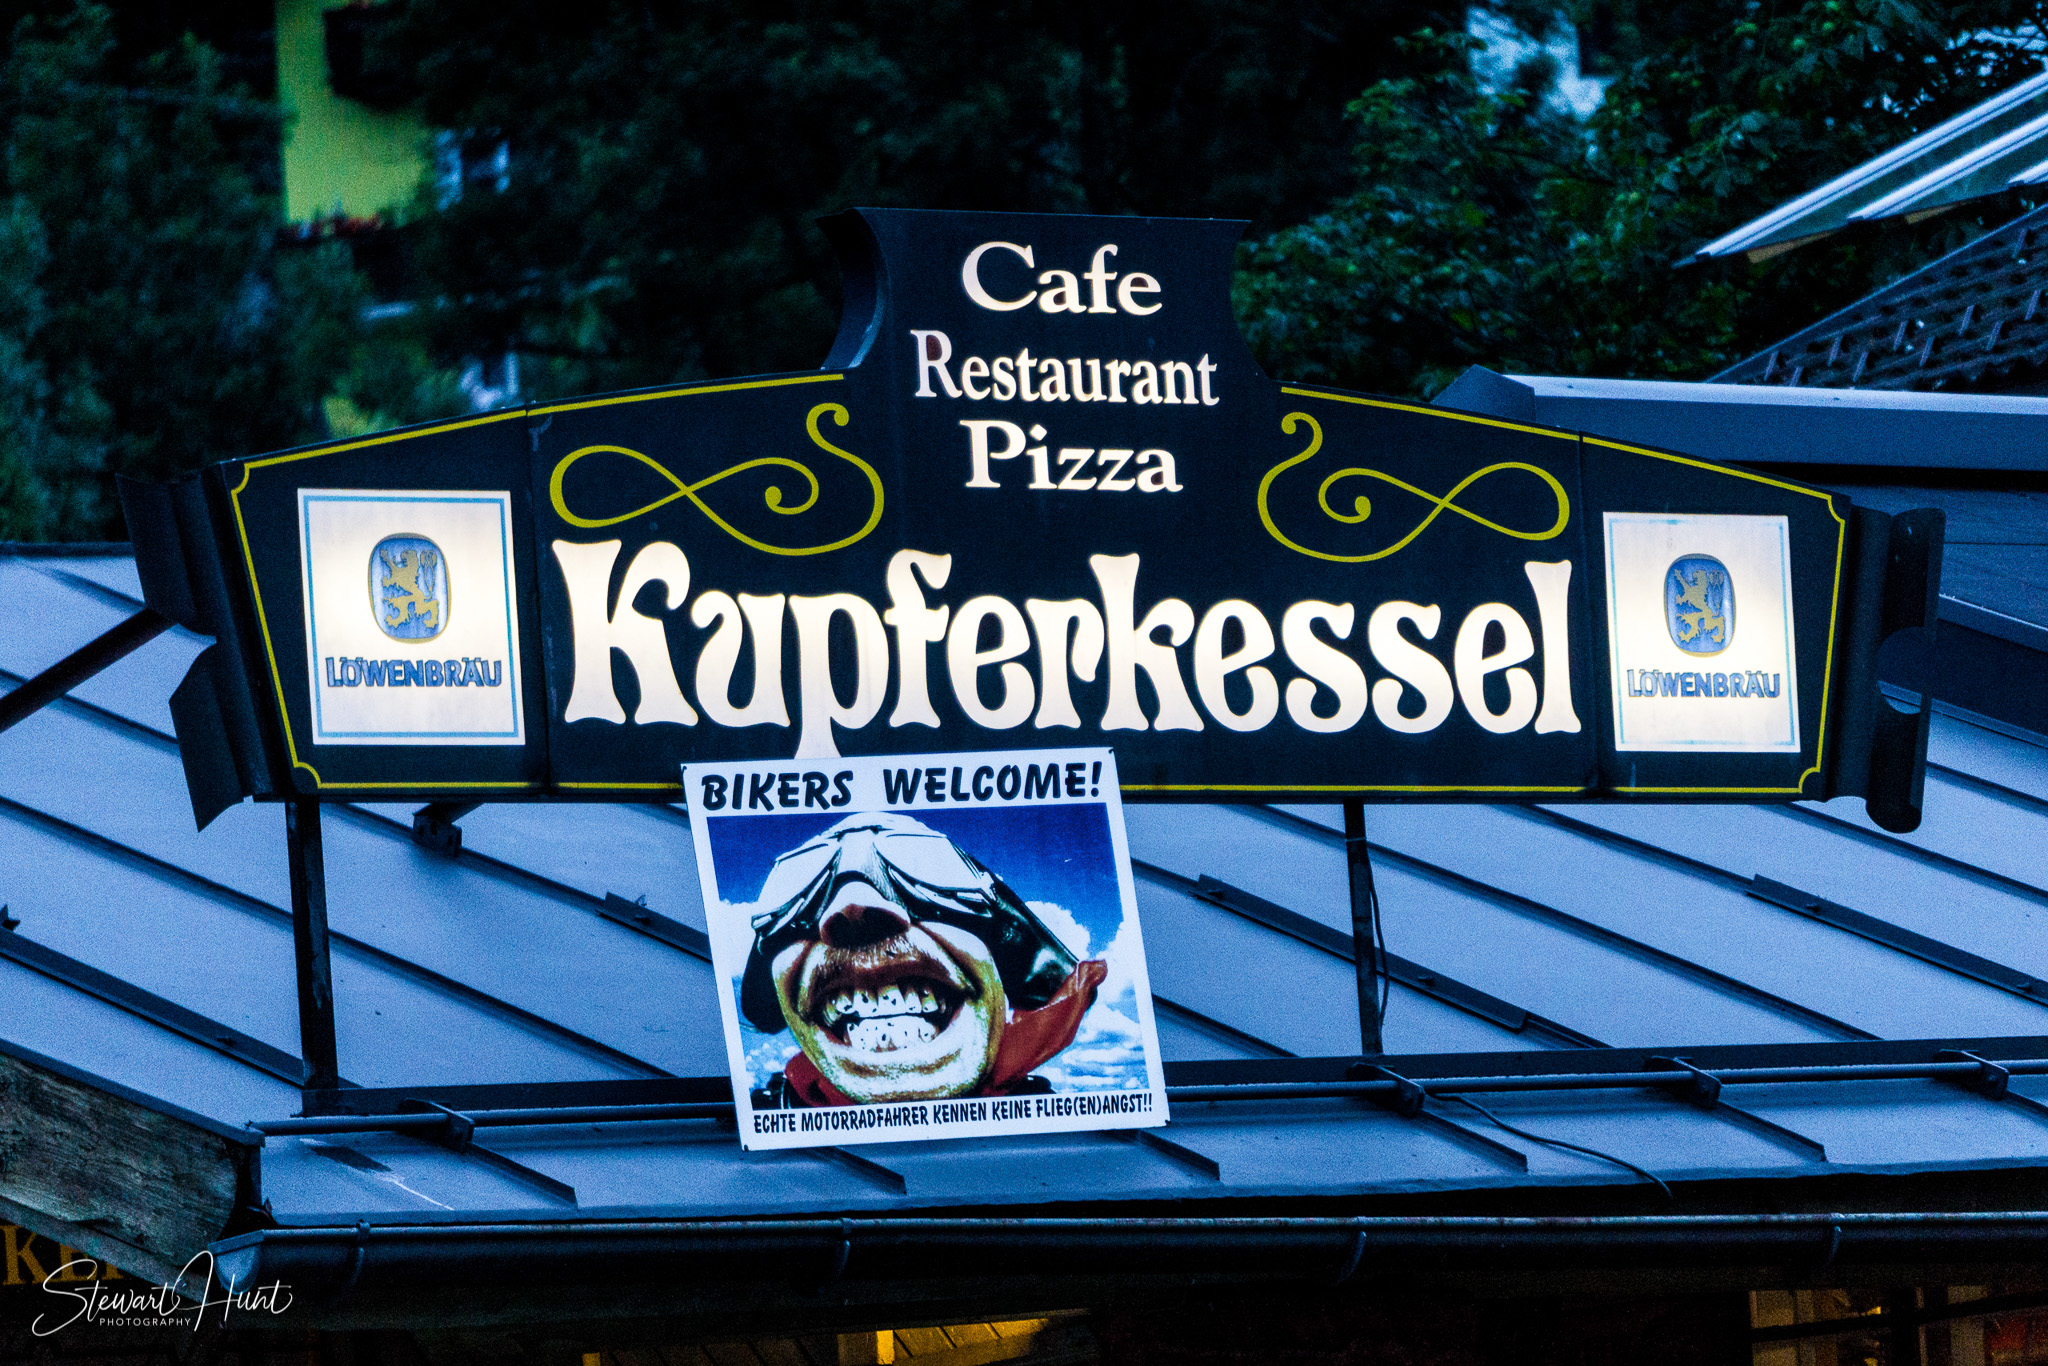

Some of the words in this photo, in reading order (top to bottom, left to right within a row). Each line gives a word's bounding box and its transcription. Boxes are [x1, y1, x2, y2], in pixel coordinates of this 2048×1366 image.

[962, 241, 1162, 316] Cafe
[910, 329, 1219, 406] Restaurant
[960, 420, 1183, 492] Pizza
[325, 656, 502, 687] LÖWENBRÄU
[552, 539, 1582, 758] Kupferkessel
[1626, 668, 1781, 698] LÖWENBRÄU
[701, 771, 854, 812] BIKERS
[884, 761, 1104, 805] WELCOME!
[753, 1113, 796, 1134] ECHTE
[801, 1105, 929, 1132] MOTORRADFAHRER
[933, 1101, 987, 1125] KENNEN
[992, 1099, 1032, 1122] KEINE
[1035, 1092, 1153, 1118] FLIEG(EN)ANGST!!
